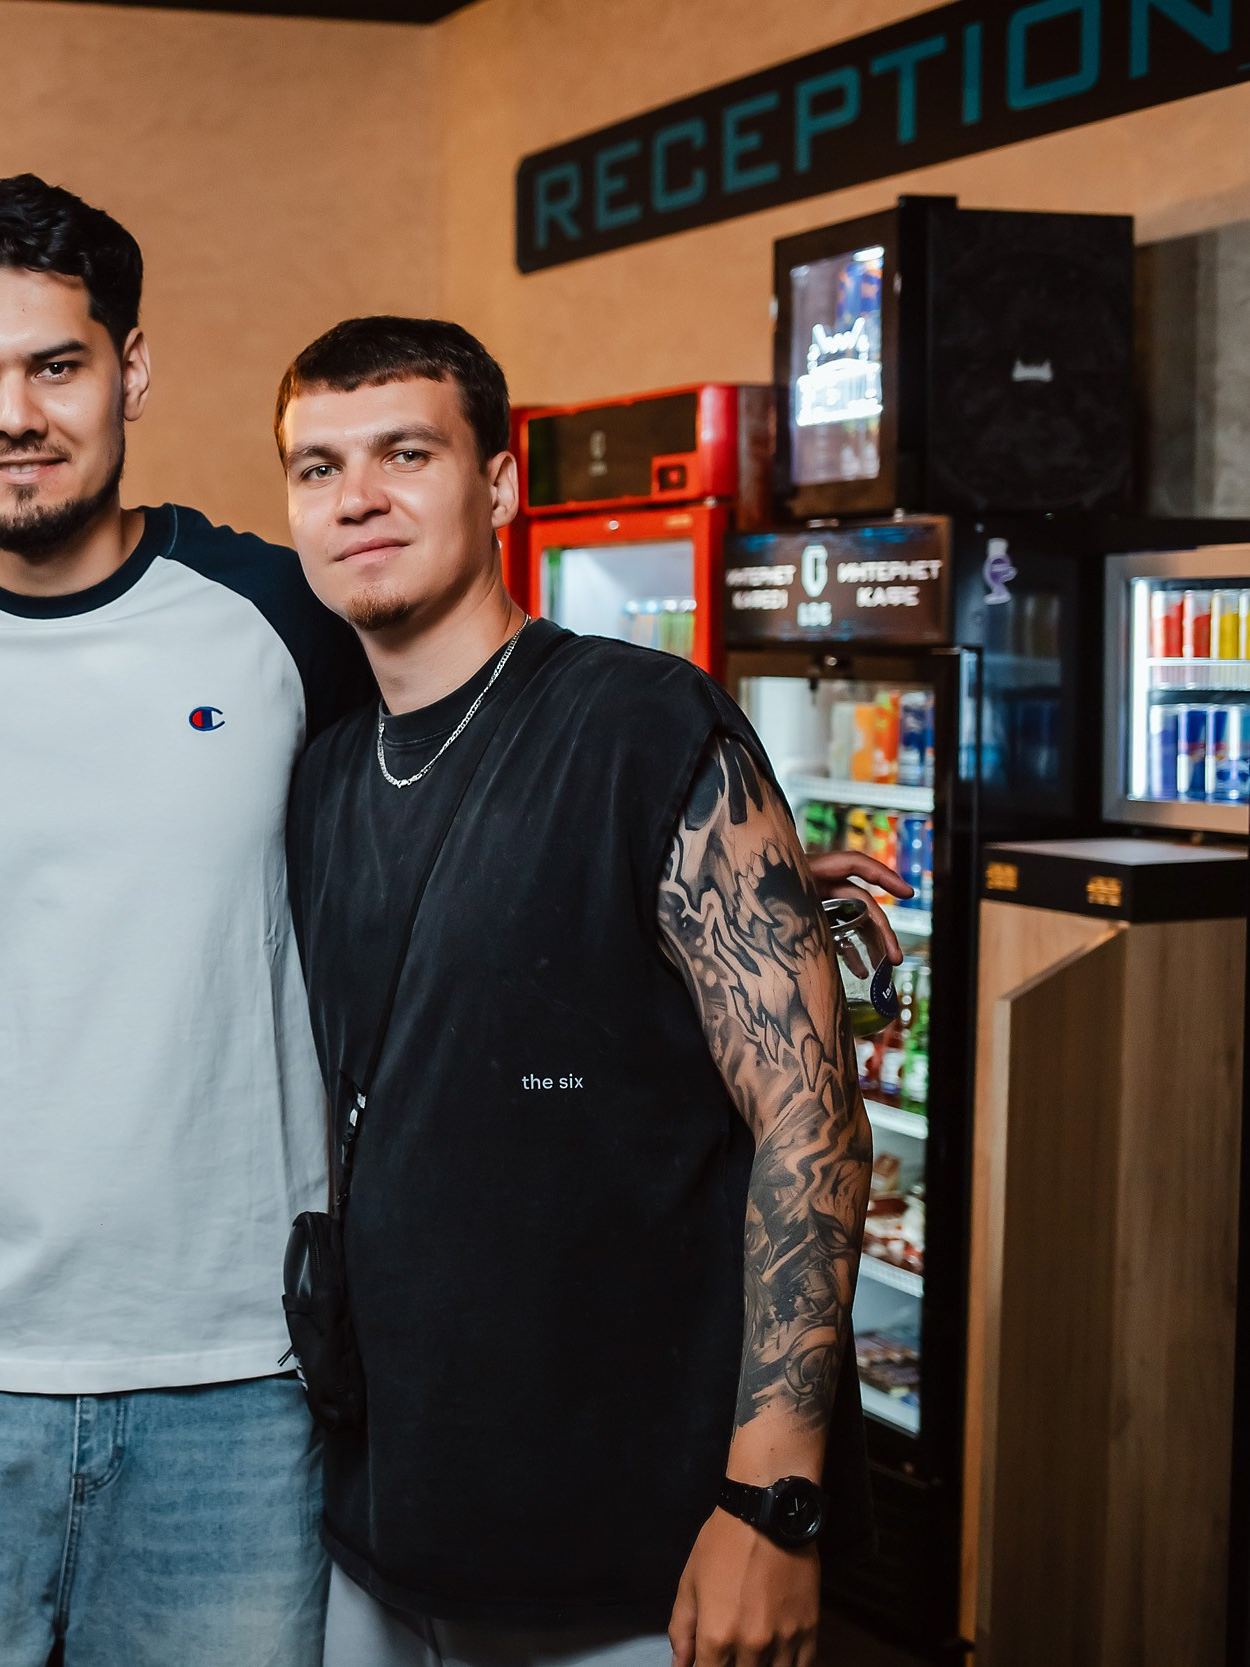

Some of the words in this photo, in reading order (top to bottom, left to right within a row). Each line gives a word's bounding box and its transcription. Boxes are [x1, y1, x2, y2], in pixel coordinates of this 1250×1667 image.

[534, 0, 1231, 249] RECEPTION
[836, 559, 943, 583] ИНТЕРНЕТ
[856, 585, 920, 607] КАФЕ
[521, 1073, 553, 1090] the
[559, 1073, 584, 1089] six
